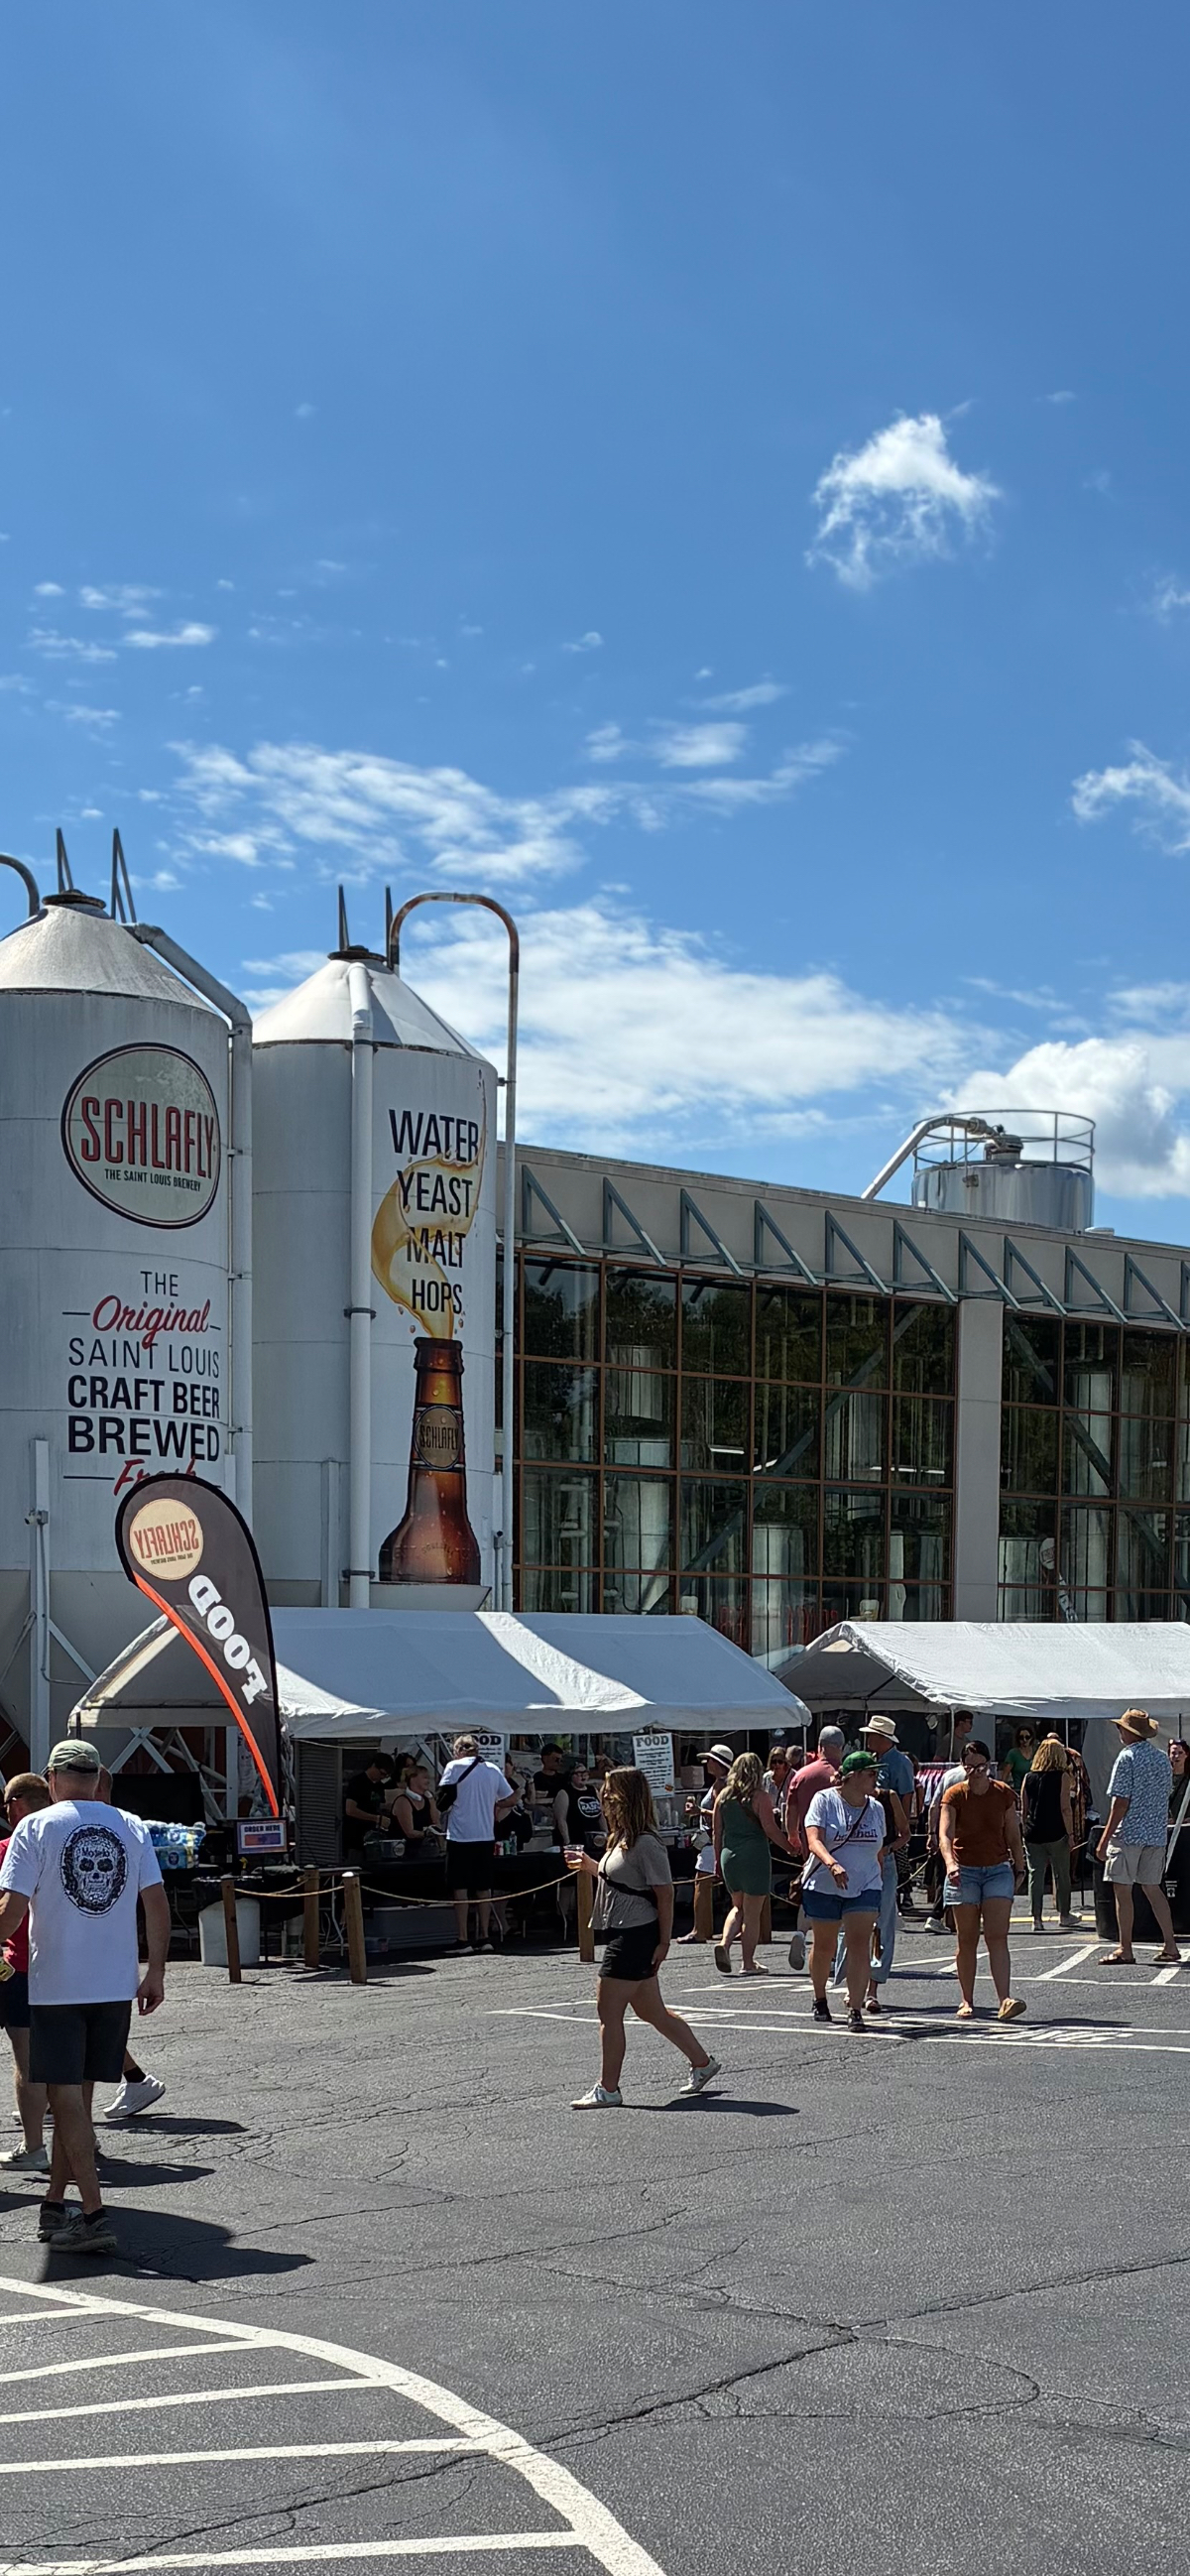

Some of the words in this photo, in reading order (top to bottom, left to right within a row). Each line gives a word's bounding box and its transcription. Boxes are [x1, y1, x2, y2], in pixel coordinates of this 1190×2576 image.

[81, 1096, 214, 1179] SCHLAFLY
[389, 1108, 479, 1166] WATER
[104, 1168, 121, 1180] THE
[123, 1169, 148, 1183] SAINT
[150, 1172, 172, 1186] LOUIS
[173, 1176, 201, 1192] BREWERY
[397, 1169, 473, 1218] YEAST
[407, 1226, 466, 1269] MALT
[140, 1271, 178, 1297] THE
[412, 1279, 463, 1314] HOPS
[92, 1294, 211, 1350] Original
[68, 1337, 159, 1370] SAINT
[169, 1344, 220, 1379] LOUIS
[67, 1374, 166, 1411] CRAFT
[173, 1381, 220, 1419] BEER
[67, 1414, 220, 1462] BREWED
[419, 1424, 459, 1451] SCHLAFLY
[635, 1735, 669, 1748] FOOD
